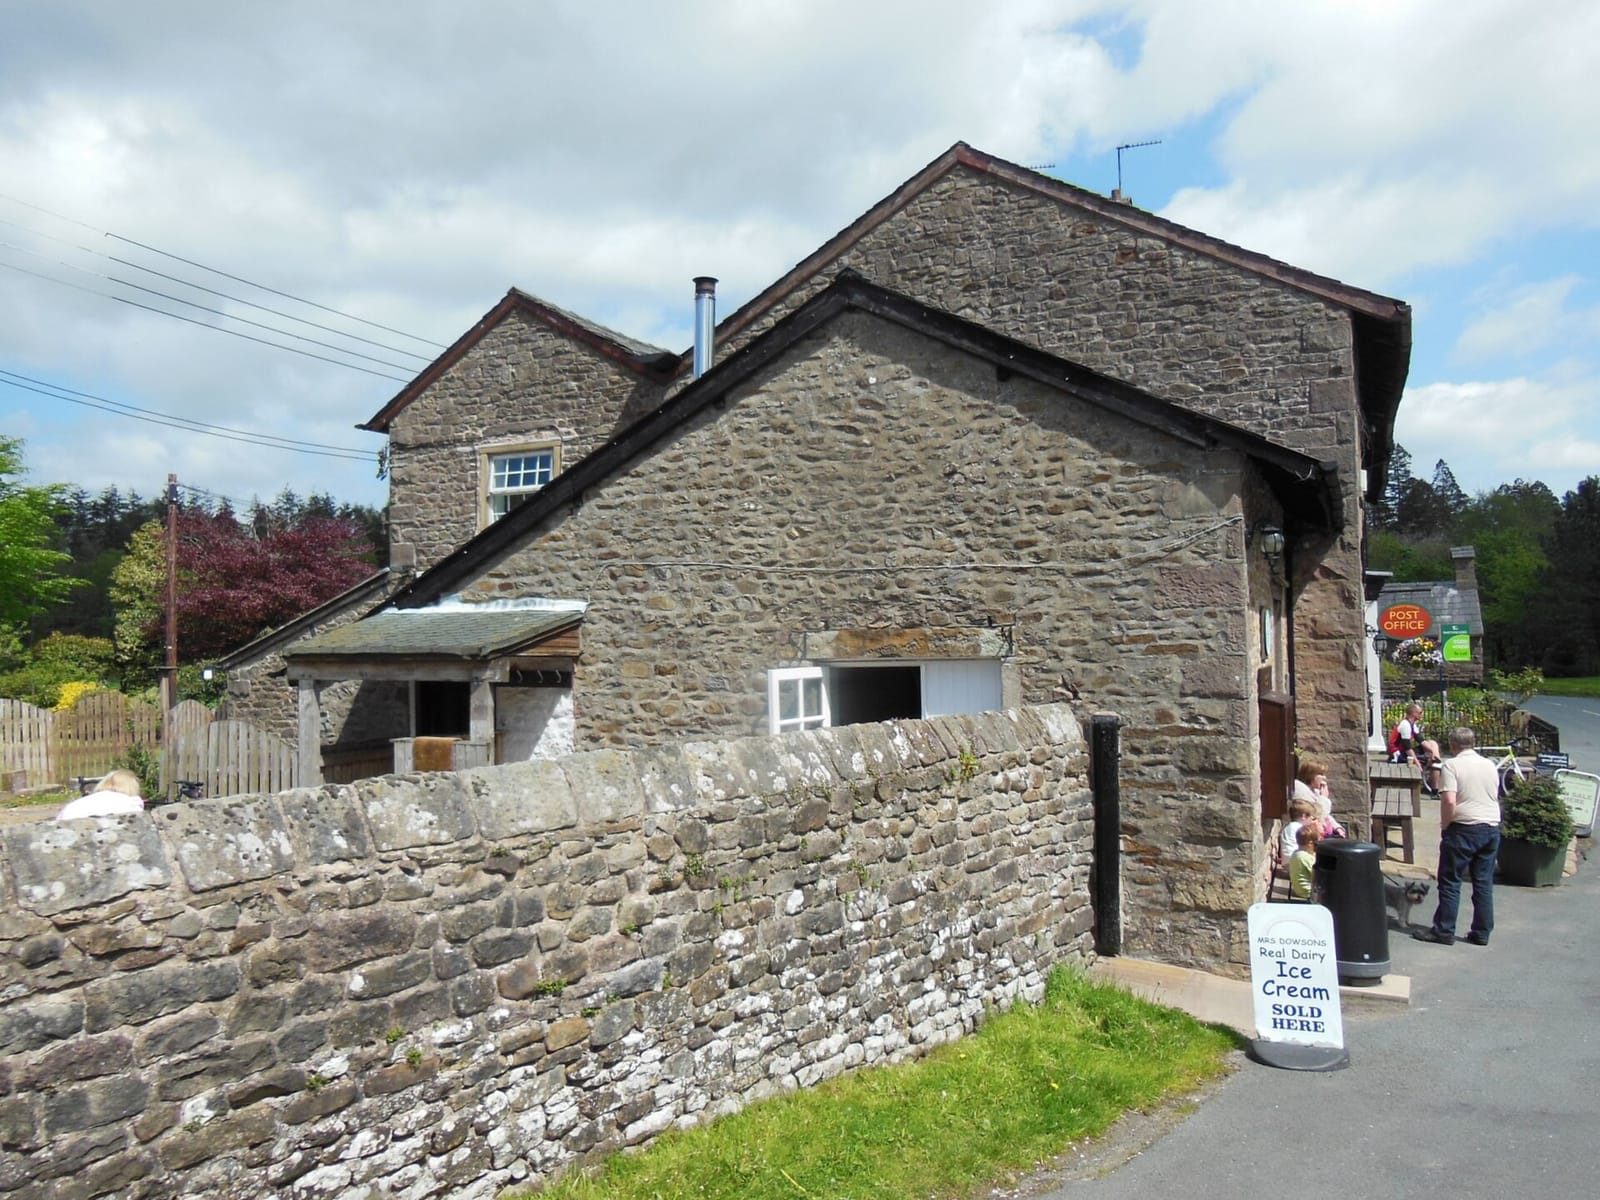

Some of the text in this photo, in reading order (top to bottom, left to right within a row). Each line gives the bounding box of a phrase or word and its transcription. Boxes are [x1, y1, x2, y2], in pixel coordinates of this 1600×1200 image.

[1389, 611, 1420, 620] POST
[1384, 620, 1425, 630] OFFICE
[1279, 937, 1327, 946] DOWSONS
[1259, 947, 1326, 963] Real Dairy
[1275, 961, 1312, 979] Ice
[1262, 980, 1330, 1000] Cream
[1272, 1003, 1322, 1019] SOLD
[1272, 1018, 1325, 1033] HERE
